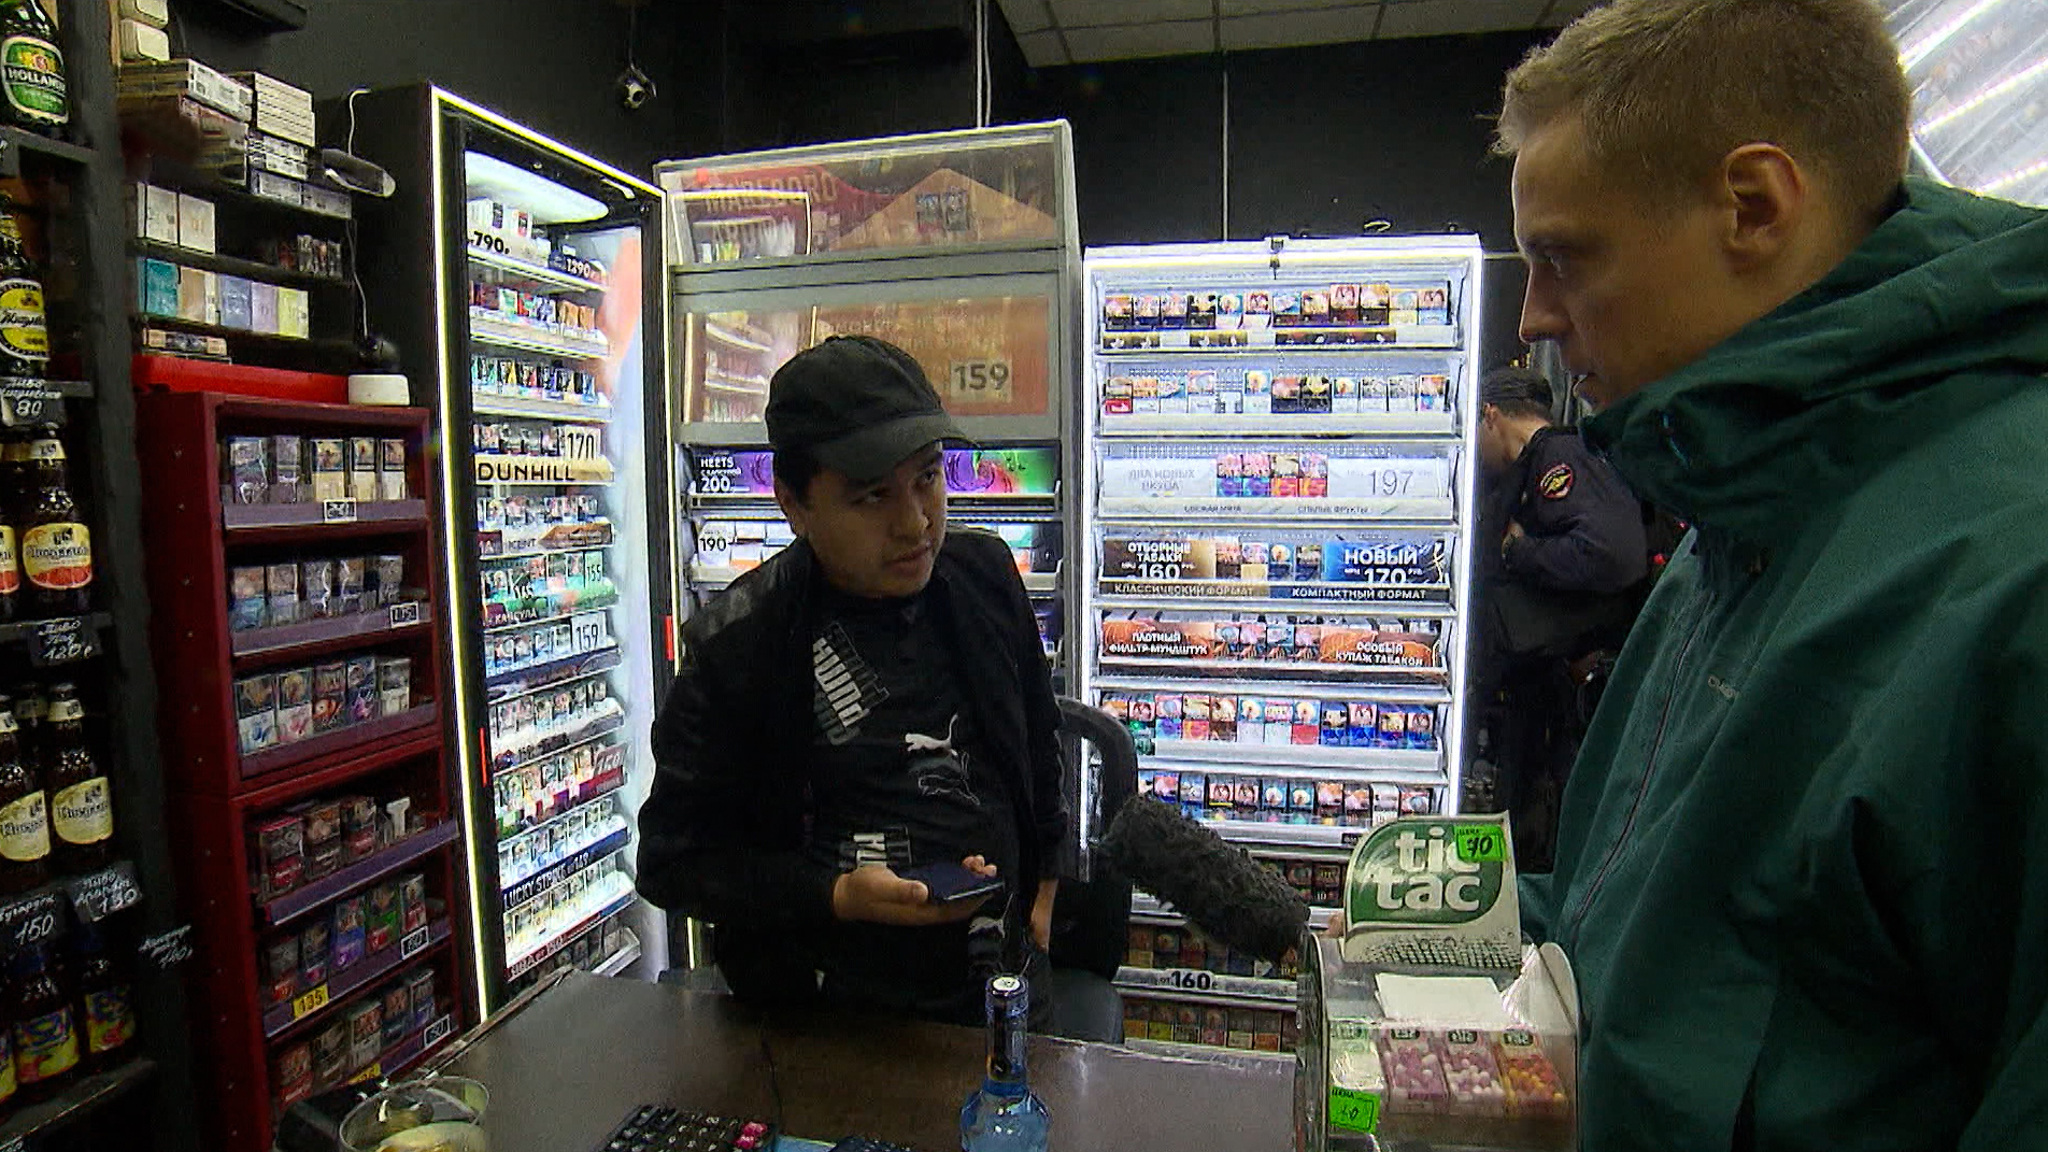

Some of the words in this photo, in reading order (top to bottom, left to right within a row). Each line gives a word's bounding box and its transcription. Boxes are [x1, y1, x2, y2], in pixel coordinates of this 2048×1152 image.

[954, 363, 1009, 391] 159
[16, 400, 43, 417] 80
[567, 432, 595, 460] 170
[700, 456, 735, 468] HEETS
[478, 462, 576, 481] DUNHILL
[701, 476, 731, 492] 200
[1369, 469, 1414, 496] 197
[699, 537, 727, 552] 190
[1136, 553, 1182, 563] ТАБАКИ
[1344, 546, 1418, 565] НОВЫЙ
[1138, 563, 1181, 579] 160
[1364, 567, 1408, 584] 170
[1114, 583, 1205, 595] КЛАССИЧЕСКИЙ
[1292, 587, 1375, 599] КОМПАКТНЫЙ
[1376, 588, 1427, 600] ФОРМАТ
[576, 623, 599, 651] 159
[1335, 650, 1372, 663] КУПАЖ
[1375, 873, 1482, 912] tac
[15, 914, 55, 945] 150
[1171, 970, 1211, 990] 160
